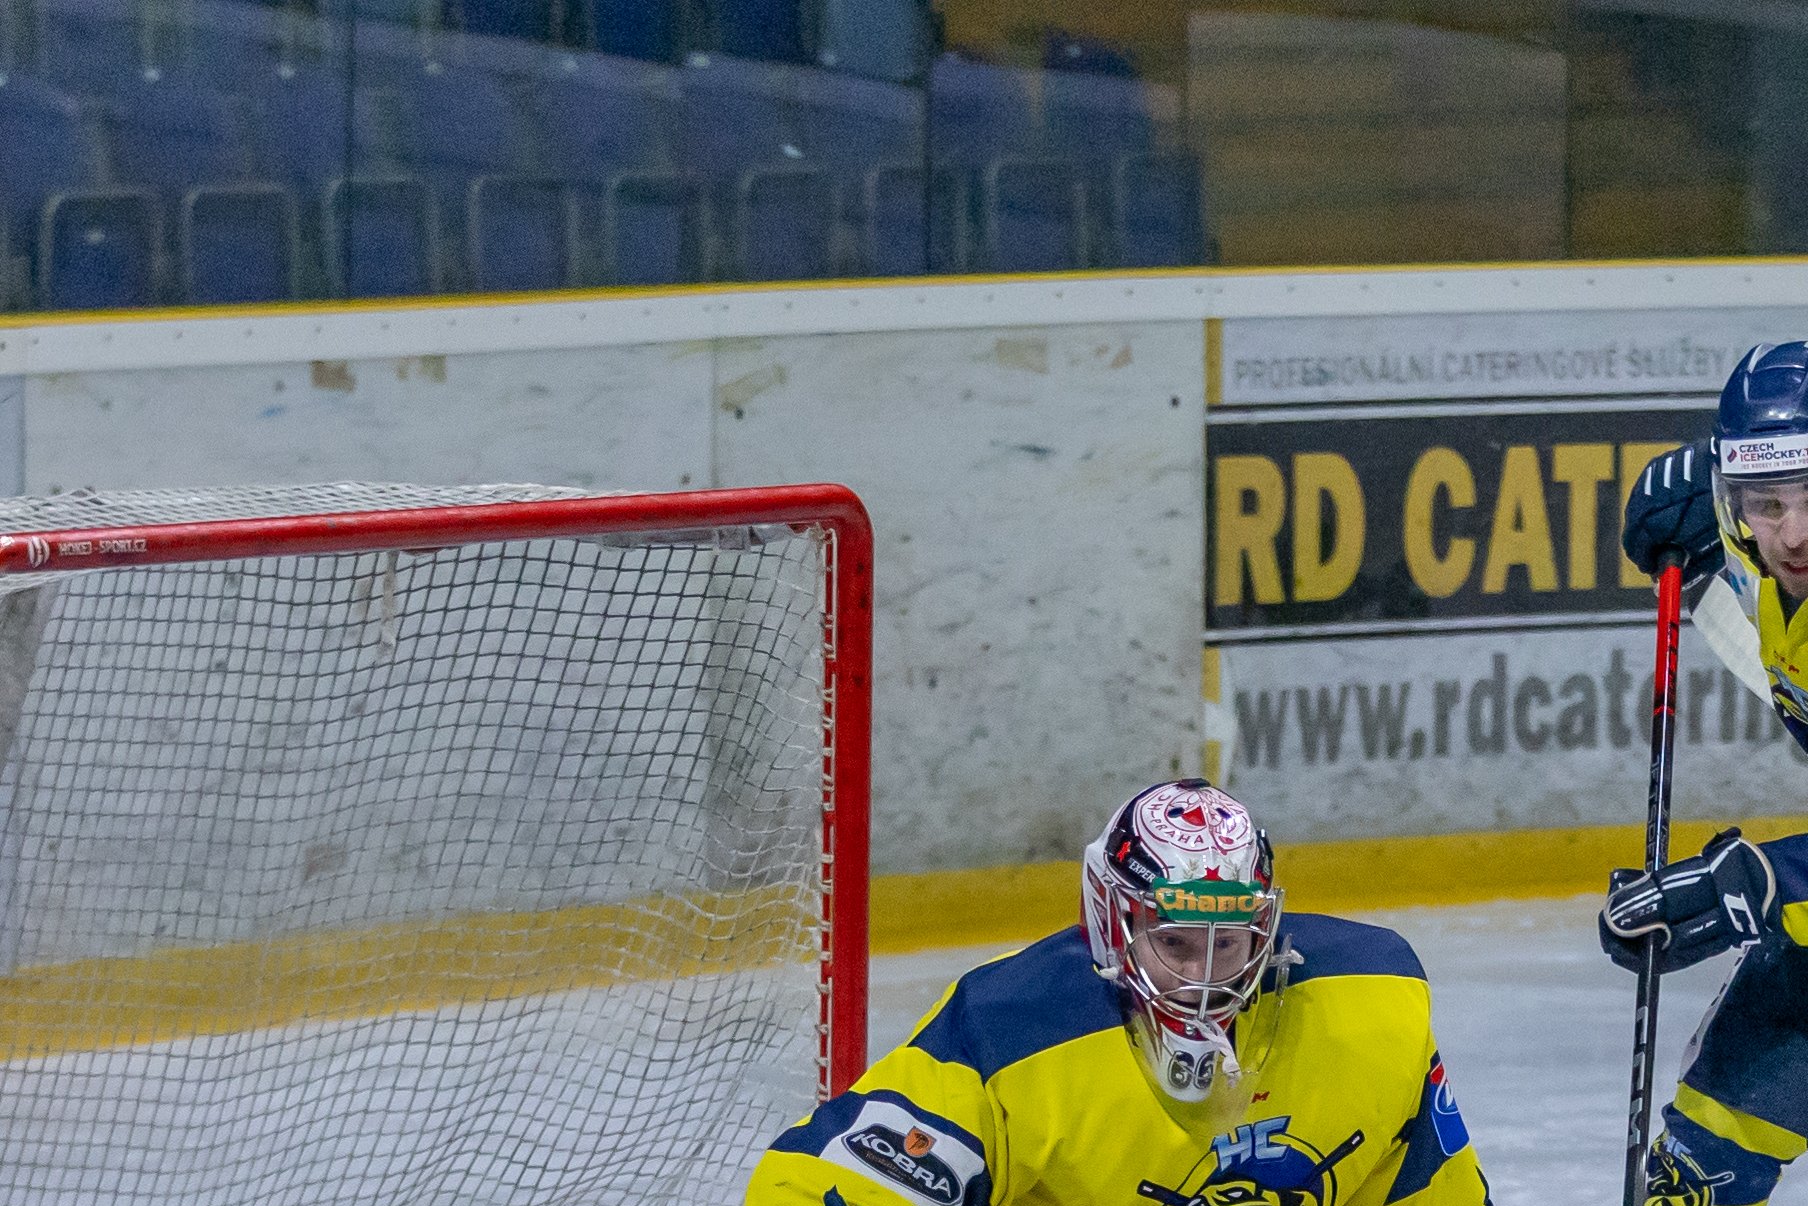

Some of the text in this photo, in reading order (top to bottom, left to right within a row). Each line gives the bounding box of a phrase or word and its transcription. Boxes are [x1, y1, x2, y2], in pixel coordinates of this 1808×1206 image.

[1739, 442, 1775, 454] CZECH
[1214, 452, 1367, 606] RD
[1155, 887, 1266, 913] Chanc
[850, 1133, 952, 1199] KOBRA
[1210, 1115, 1292, 1172] HC
